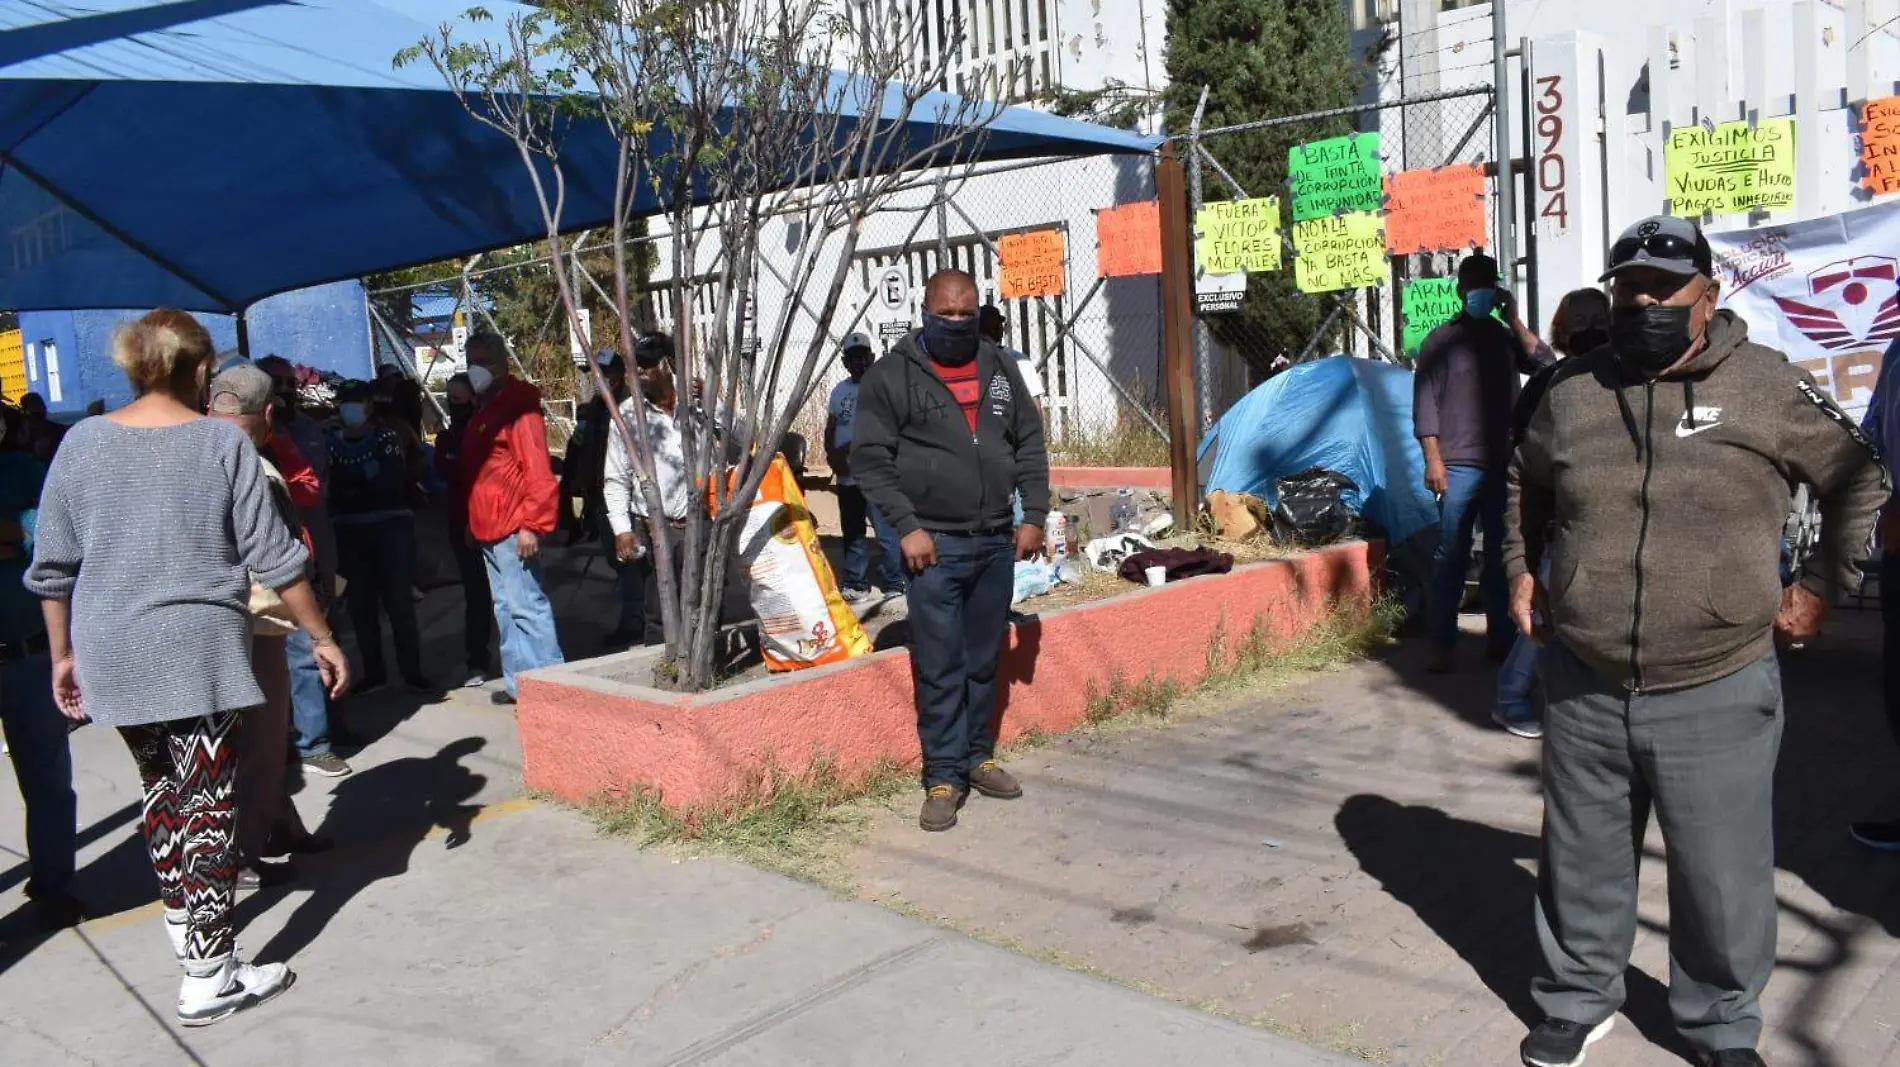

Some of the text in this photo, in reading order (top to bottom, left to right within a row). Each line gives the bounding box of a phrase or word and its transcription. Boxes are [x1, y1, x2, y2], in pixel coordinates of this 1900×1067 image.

[1673, 127, 1782, 149] EXIGIMOS
[1305, 142, 1359, 165] BASTA
[1536, 75, 1567, 229] 3904
[1689, 145, 1775, 163] JUSTICIA
[1296, 170, 1313, 185] DE
[1674, 172, 1736, 193] VIUDAS
[1744, 173, 1752, 187] E
[1673, 197, 1724, 212] PAGOS
[1299, 219, 1318, 239] NO
[1332, 217, 1348, 233] LA
[1215, 238, 1273, 255] FLORES
[1302, 251, 1369, 274] YA BASTA
[1009, 275, 1061, 294] YA BASTA
[1308, 273, 1329, 287] NO
[1198, 292, 1244, 302] EXCLUSIVO
[1201, 302, 1239, 311] PERSONAL
